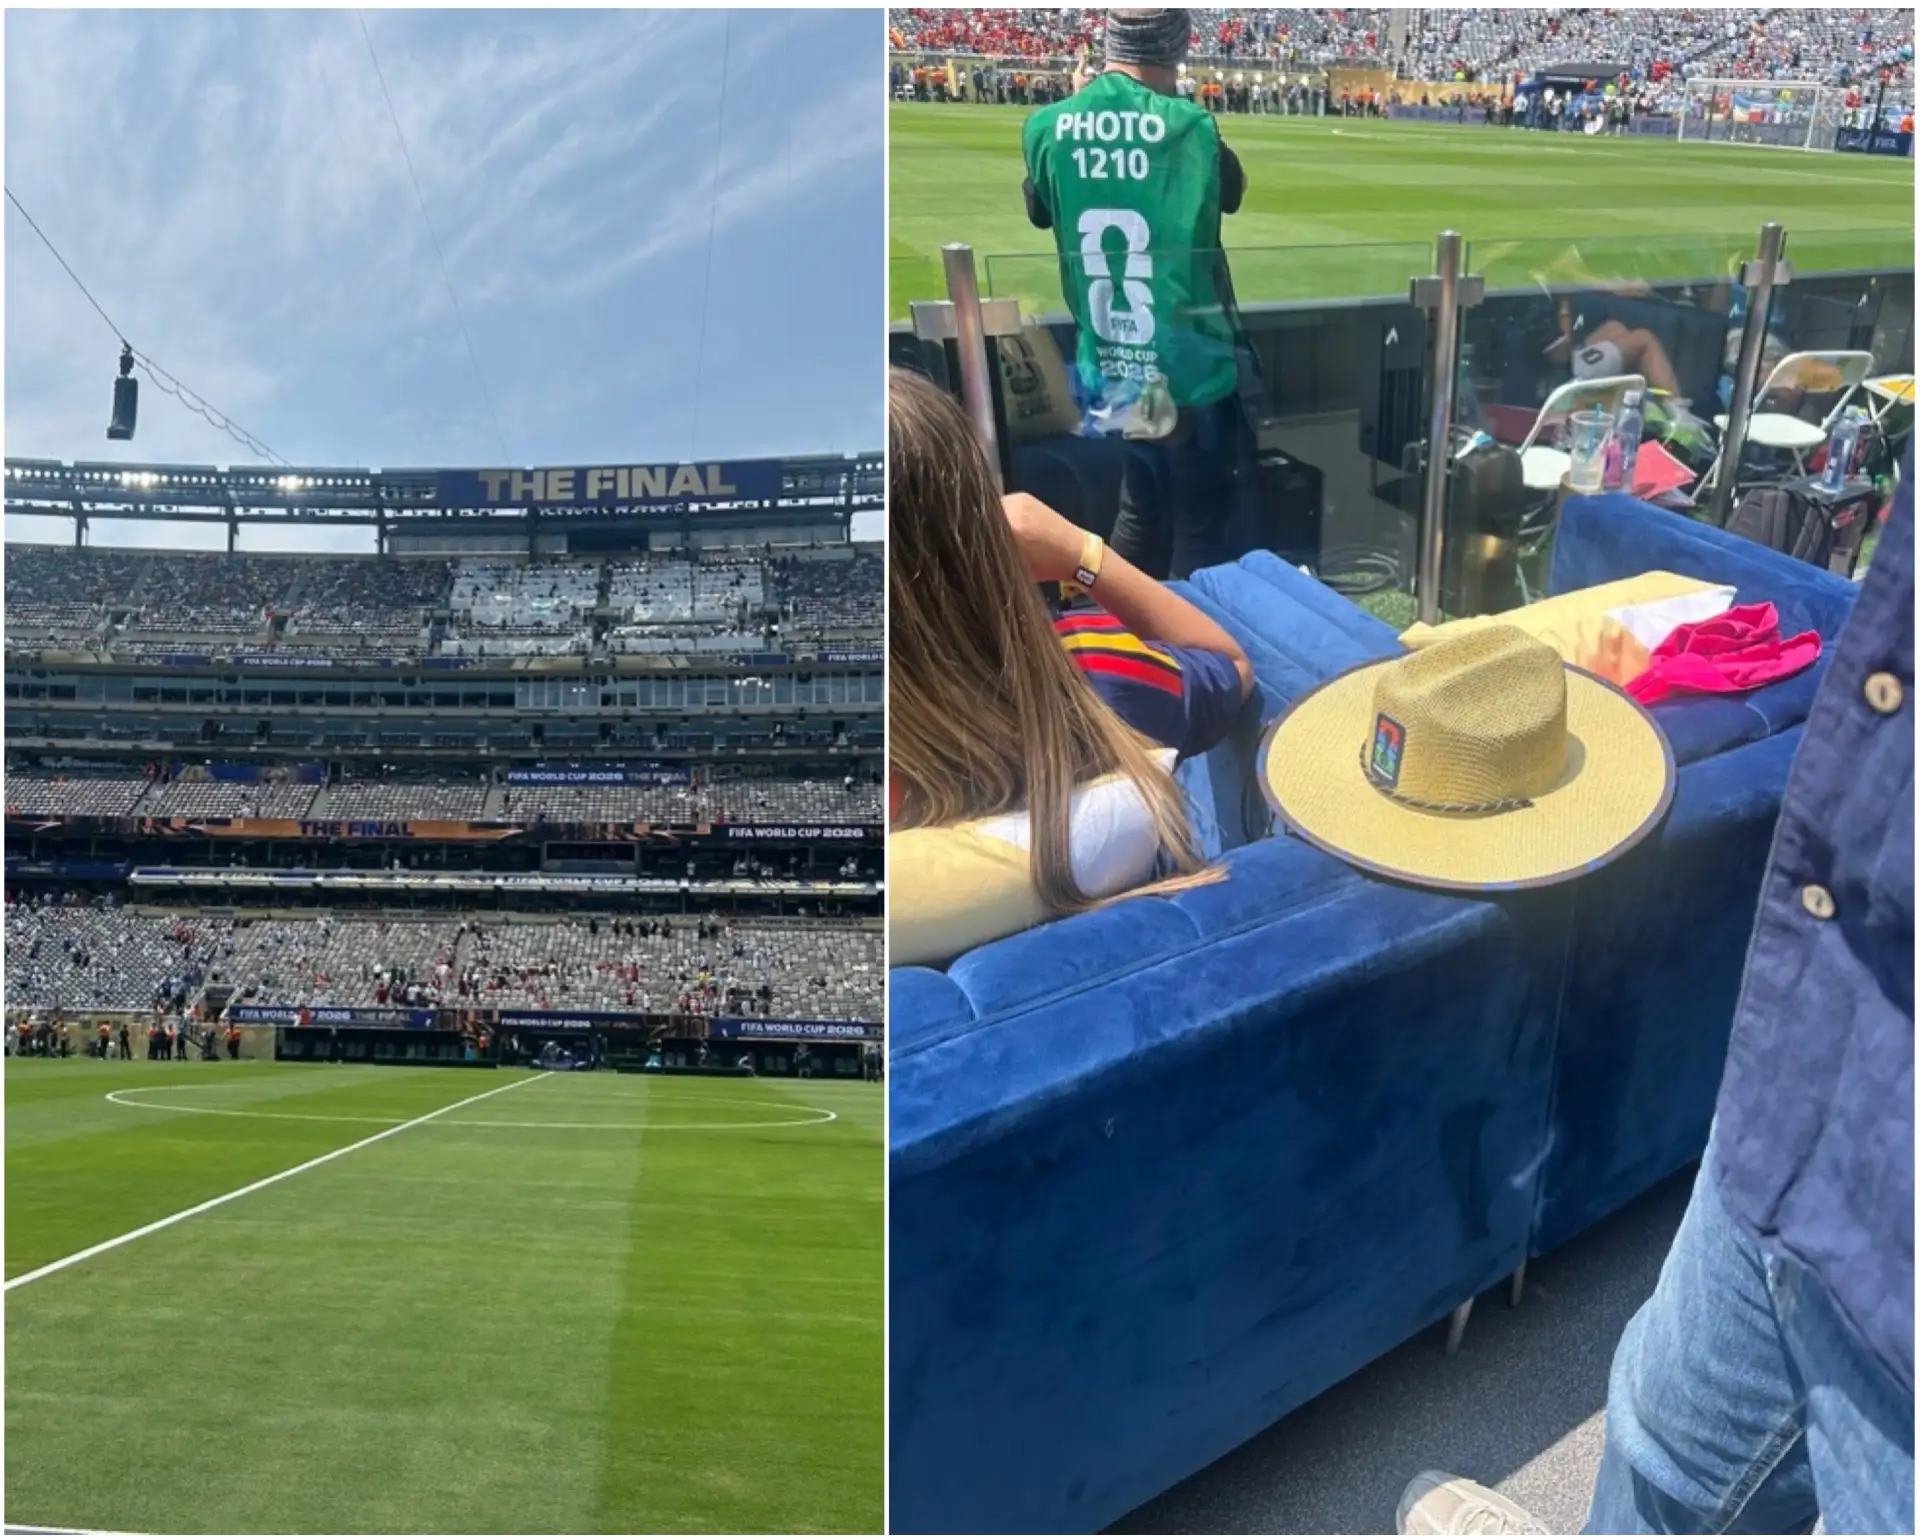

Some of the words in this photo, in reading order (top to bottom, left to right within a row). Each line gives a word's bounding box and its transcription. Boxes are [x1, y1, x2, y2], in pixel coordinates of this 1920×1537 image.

[1055, 110, 1165, 143] PHOTO
[1071, 147, 1150, 180] 1210
[1110, 317, 1139, 333] FIFA
[1096, 346, 1134, 361] WORLD
[1134, 349, 1158, 362] CUP
[1100, 359, 1162, 383] 2026
[478, 469, 575, 501] THE
[586, 464, 736, 499] FINAL
[507, 772, 529, 780] FIFA
[530, 772, 566, 781] WORLD
[567, 772, 587, 781] CUP
[588, 773, 624, 781] 2026
[628, 773, 650, 781] THE
[299, 821, 342, 835] THE
[347, 822, 415, 836] FINAL
[729, 828, 754, 837] FIFA
[754, 828, 797, 837] WORLD
[797, 828, 821, 837] CUP
[822, 828, 864, 838] 2026
[239, 1010, 259, 1018] FIFA
[261, 1010, 295, 1019] WORLD
[316, 1010, 351, 1020] 2026
[519, 1018, 546, 1026] WORLD
[563, 1020, 591, 1028] 2026
[741, 1022, 764, 1031] FIFA
[764, 1023, 803, 1033] WORLD
[803, 1024, 826, 1034] CUP
[826, 1025, 864, 1035] 2026
